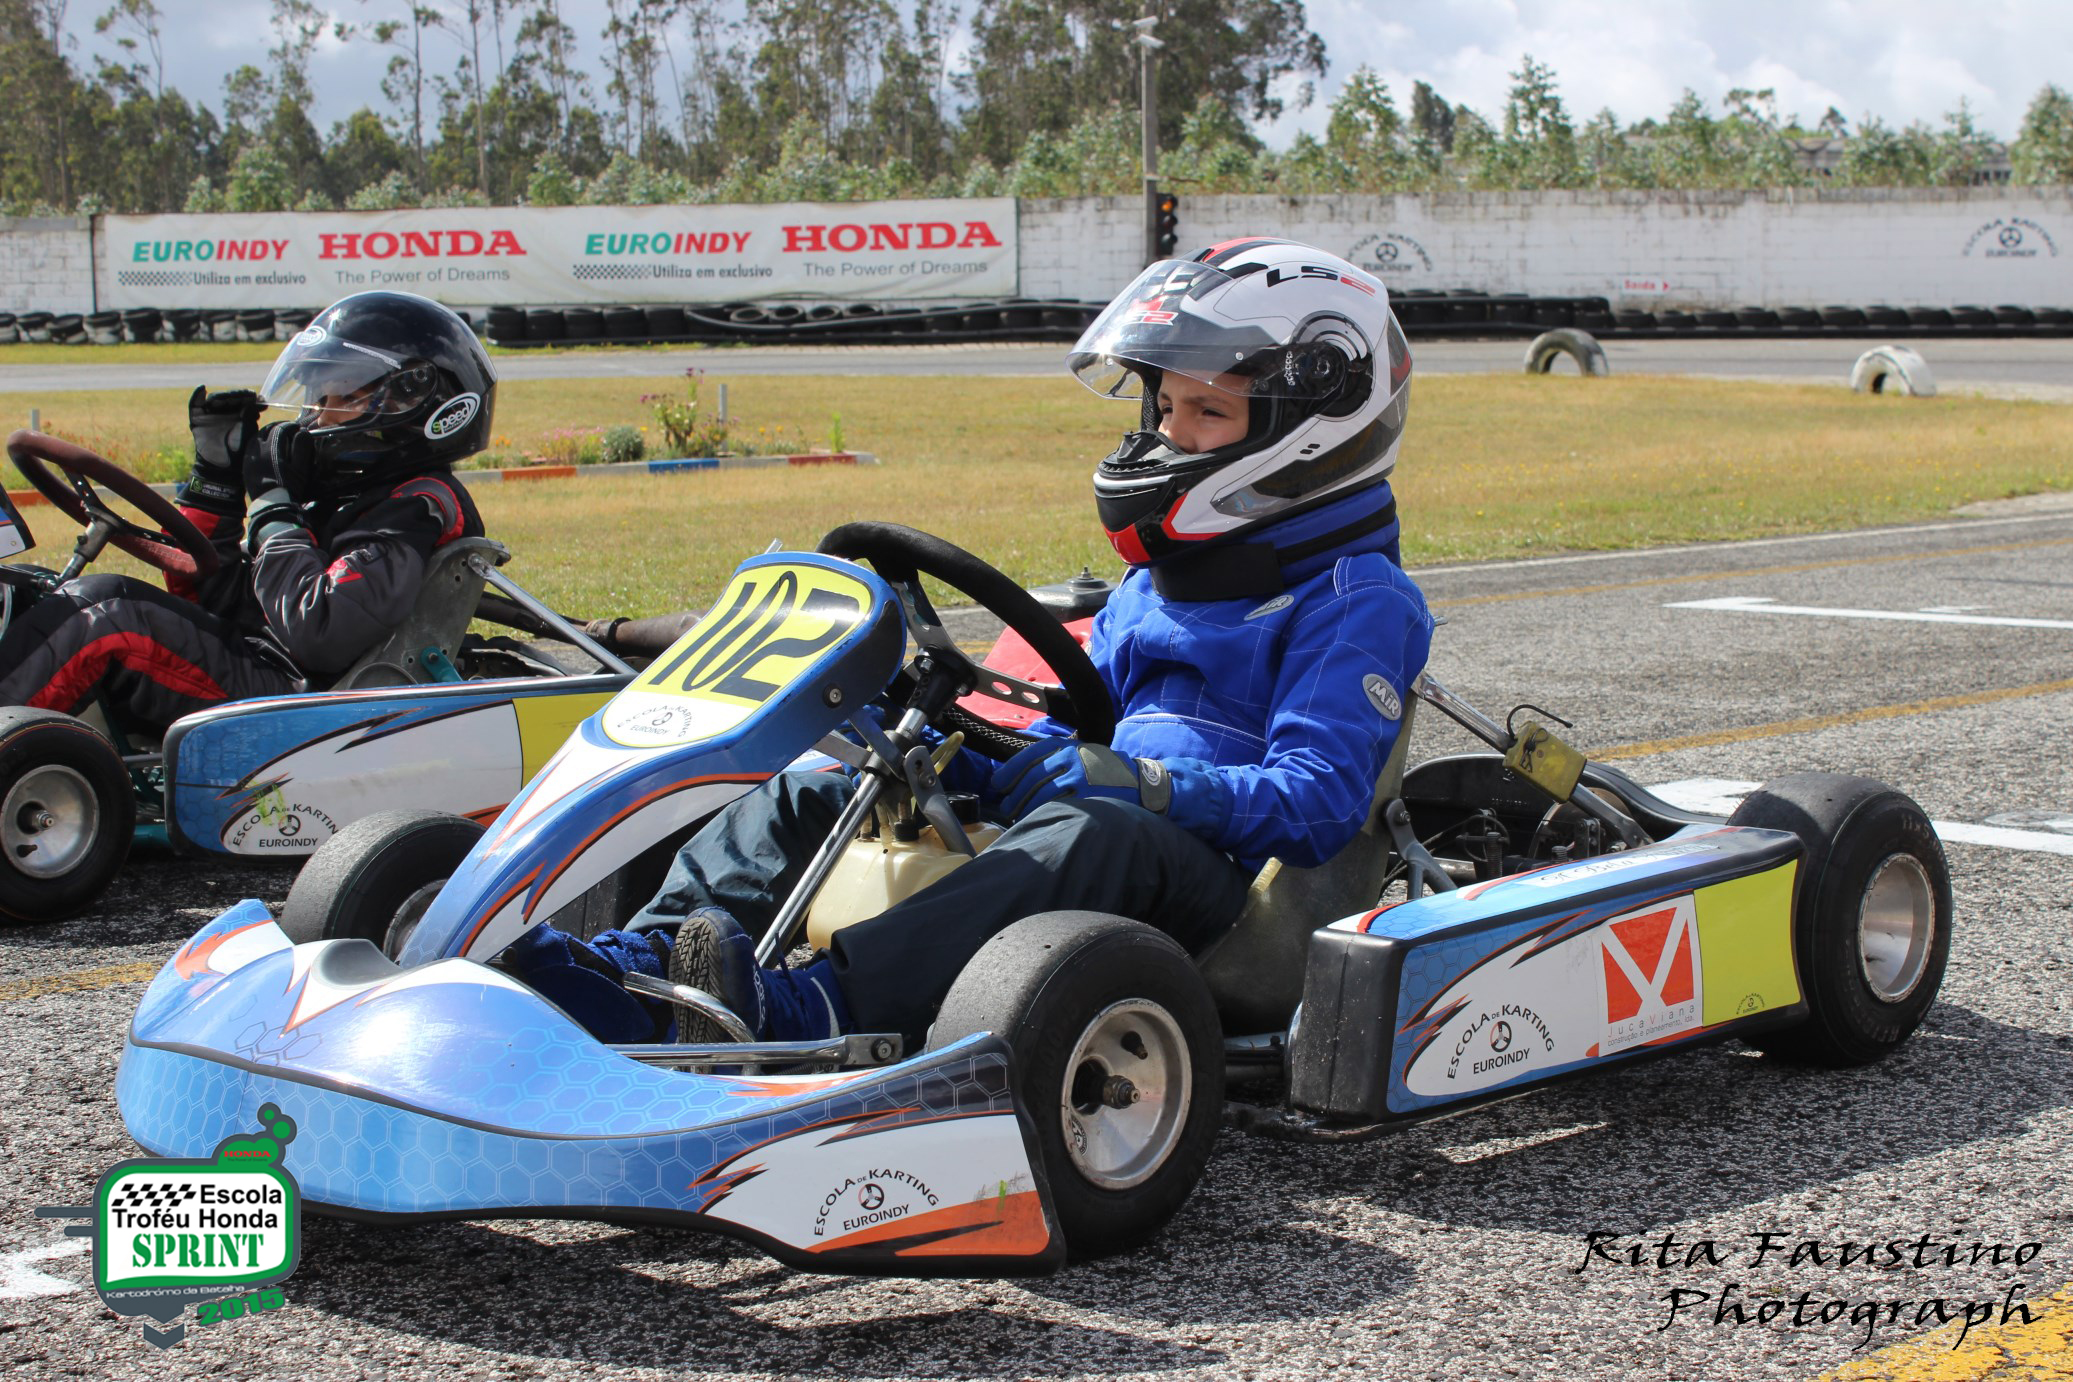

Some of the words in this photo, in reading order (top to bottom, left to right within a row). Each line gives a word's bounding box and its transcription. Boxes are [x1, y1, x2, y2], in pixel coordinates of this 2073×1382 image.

[132, 239, 290, 262] EUROINDY
[318, 230, 528, 259] HONDA
[585, 231, 752, 255] EUROINDY
[781, 221, 1002, 252] HONDA
[194, 271, 231, 285] Utiliza
[235, 274, 251, 285] em
[255, 270, 306, 285] exclusivo
[335, 270, 365, 284] The
[371, 269, 420, 283] Power
[427, 267, 443, 281] of
[448, 267, 510, 281] Dreams
[652, 264, 692, 278] Utiliza
[696, 267, 715, 278] em
[719, 263, 773, 278] exclusivo
[803, 262, 835, 277] The
[841, 262, 893, 276] Power
[899, 260, 915, 275] of
[921, 260, 988, 275] Dreams
[1266, 265, 1376, 297] LS2
[647, 570, 865, 702] 102
[233, 806, 280, 846] ESCOLA
[292, 803, 339, 835] KARTIN
[259, 838, 319, 848] EUROINDY
[1447, 1012, 1491, 1080] ESCOLA
[1491, 1011, 1500, 1020] DE
[1502, 1003, 1555, 1052] KARTING
[1473, 1047, 1530, 1075] EUROINDY
[813, 1177, 856, 1236] ESCOLA
[857, 1175, 867, 1183] DE
[868, 1168, 939, 1207] KARTING
[843, 1203, 910, 1231] EUROINDY
